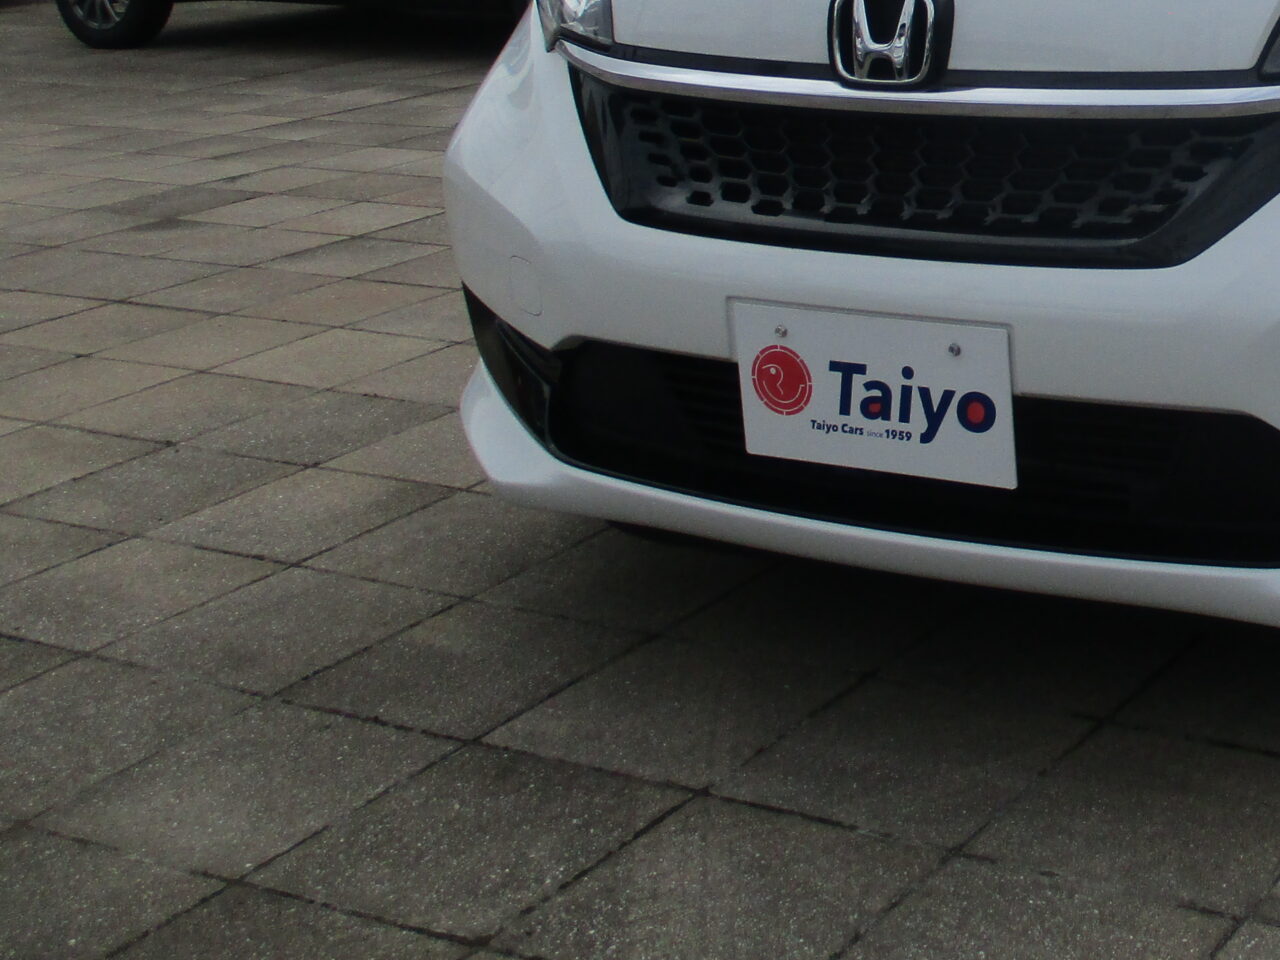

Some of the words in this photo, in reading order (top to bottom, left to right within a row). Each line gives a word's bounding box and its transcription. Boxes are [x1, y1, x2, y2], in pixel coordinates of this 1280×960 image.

[829, 360, 996, 444] Taiyo
[810, 419, 838, 434] Taiyo
[841, 423, 864, 436] Cars
[866, 430, 884, 439] since
[885, 429, 912, 441] 1959
